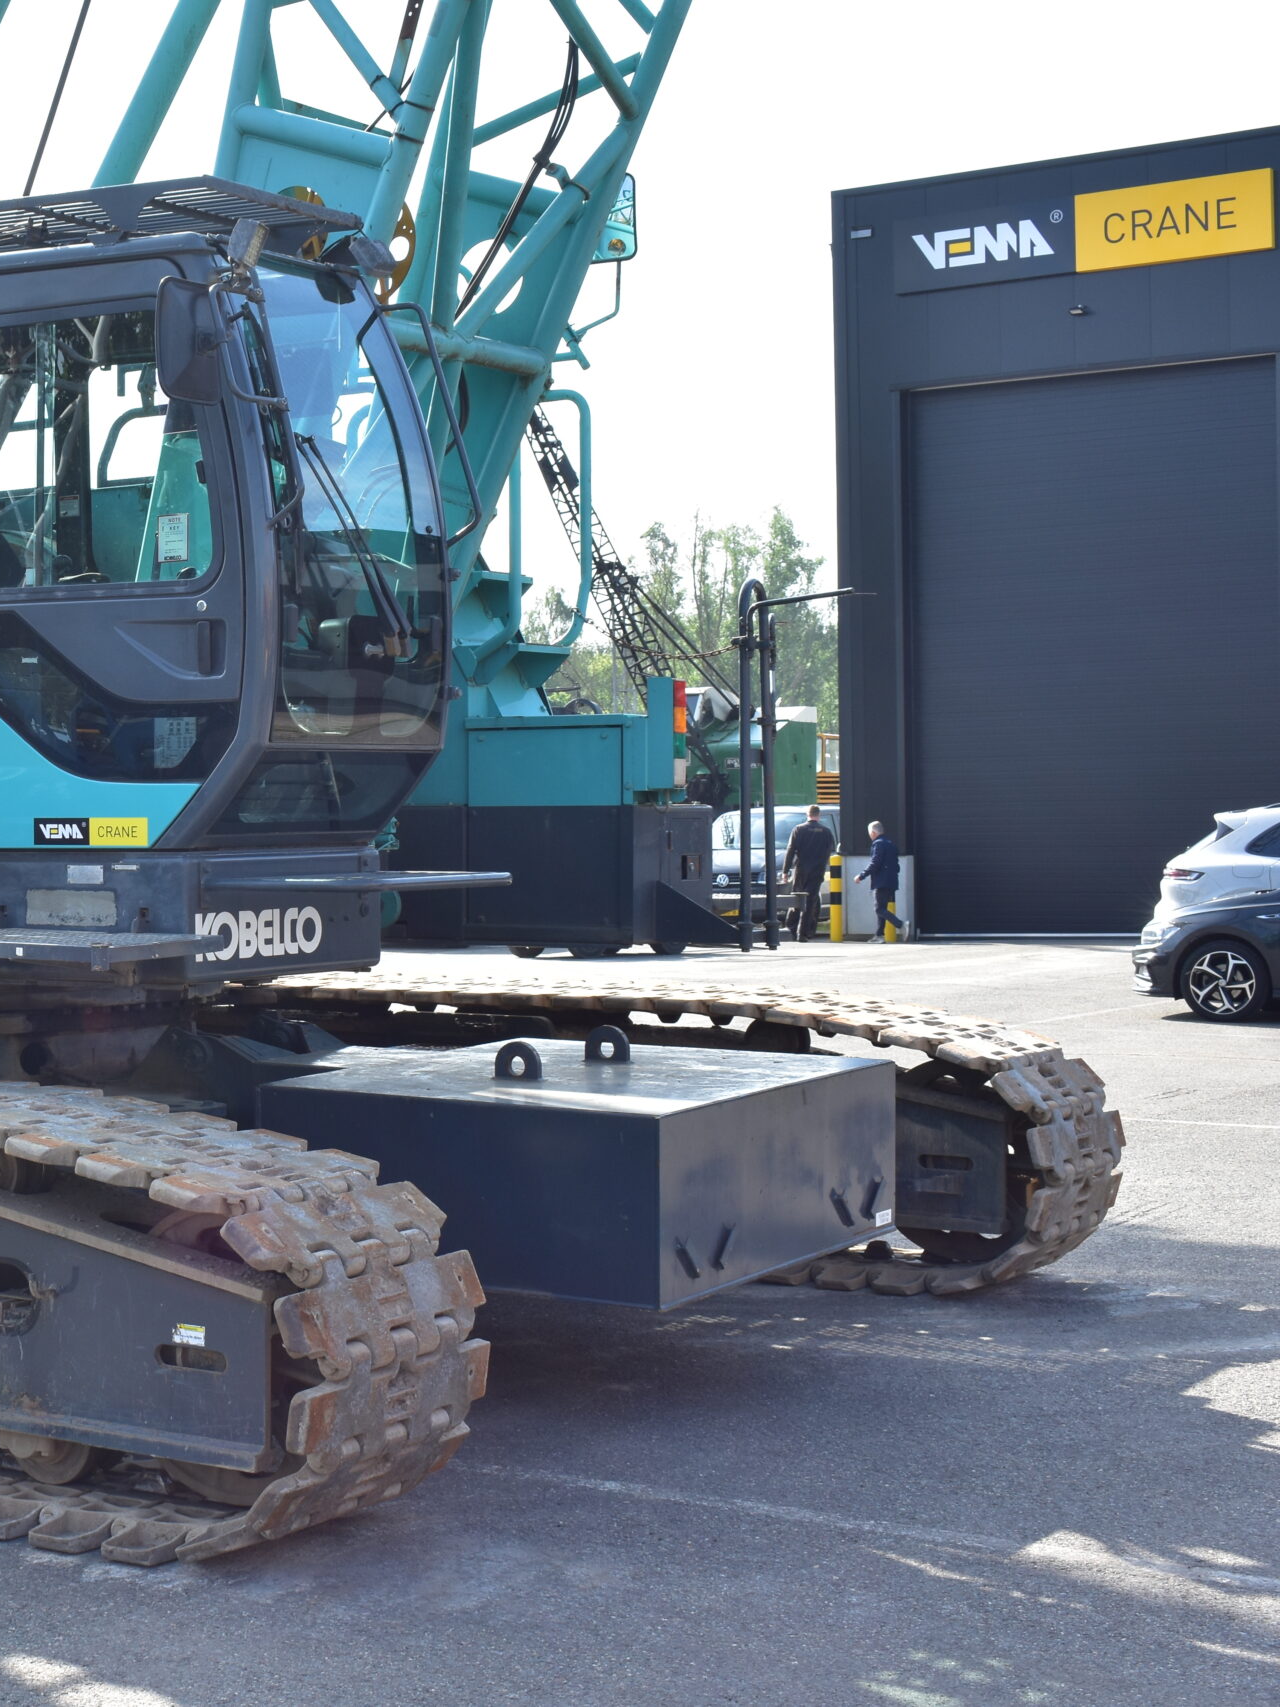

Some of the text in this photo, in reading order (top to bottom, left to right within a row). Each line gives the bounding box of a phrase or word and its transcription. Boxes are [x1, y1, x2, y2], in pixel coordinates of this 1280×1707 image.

[1103, 196, 1237, 244] CRANE
[97, 825, 138, 838] CRANE
[194, 906, 322, 962] KOBELCO
